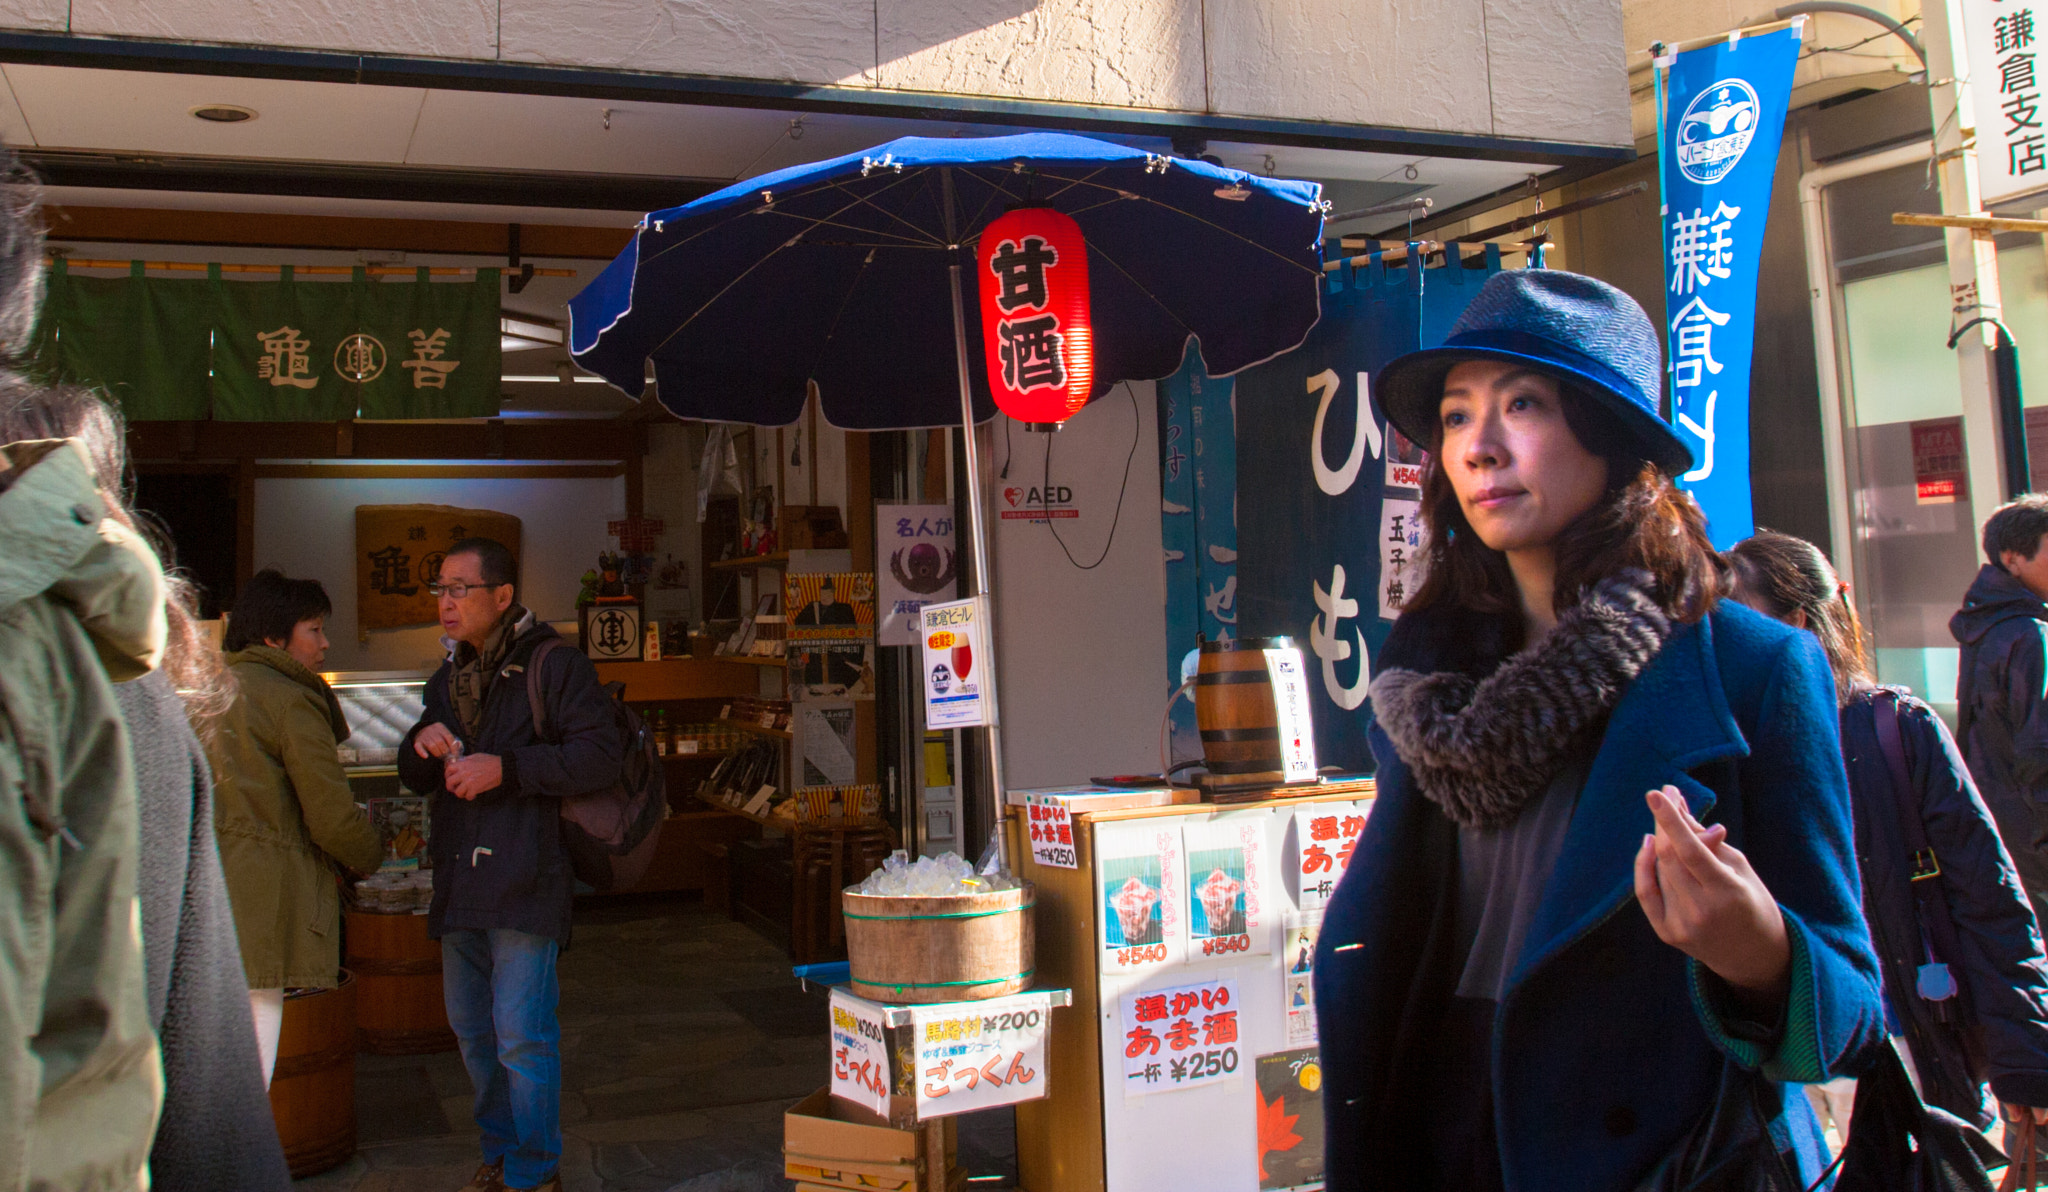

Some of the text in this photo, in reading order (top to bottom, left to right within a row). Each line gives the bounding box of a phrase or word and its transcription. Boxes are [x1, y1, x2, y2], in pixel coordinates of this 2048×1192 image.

[1993, 8, 2047, 176] 鎌倉支店
[990, 235, 1067, 395] 甘酒
[1026, 486, 1073, 504] AED
[896, 517, 954, 537] 名人が
[1306, 367, 1383, 771] ひも
[893, 600, 933, 614] 浜茹
[925, 606, 973, 628] 鎌倉ビール
[1029, 804, 1066, 821] 温かい
[1030, 822, 1073, 846] あま酒
[1047, 847, 1075, 866] ¥250
[1117, 943, 1168, 966] ¥540
[1202, 933, 1251, 956] ¥540
[1134, 986, 1230, 1023] 温かい
[858, 1018, 882, 1043] ¥200
[924, 1009, 1040, 1044] 馬路村 ¥200
[1125, 1010, 1238, 1059] あま酒
[834, 1045, 887, 1098] ごっくん
[924, 1051, 1036, 1099] ごっくん
[1128, 1046, 1239, 1084] 一杯 ¥250
